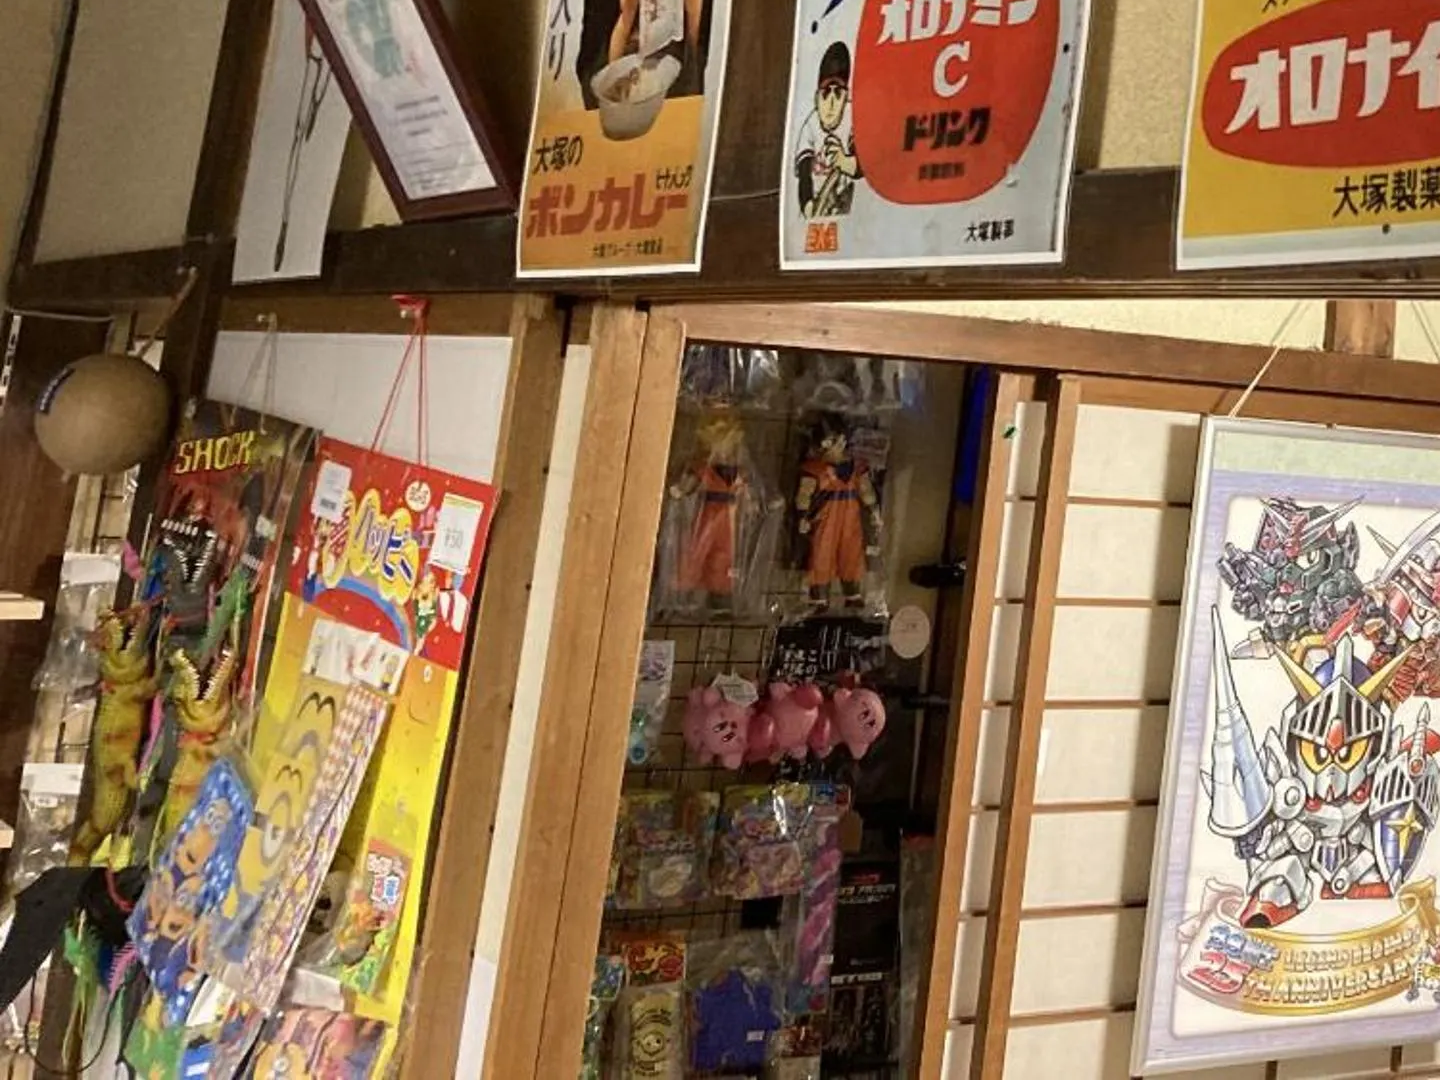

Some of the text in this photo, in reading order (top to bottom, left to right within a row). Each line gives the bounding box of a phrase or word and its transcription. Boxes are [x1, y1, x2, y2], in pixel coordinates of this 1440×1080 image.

[932, 41, 970, 98] C
[903, 107, 992, 151] ドリンク
[534, 135, 584, 174] 大塚の
[525, 173, 688, 239] ボンカレー
[174, 430, 255, 474] SHOCK
